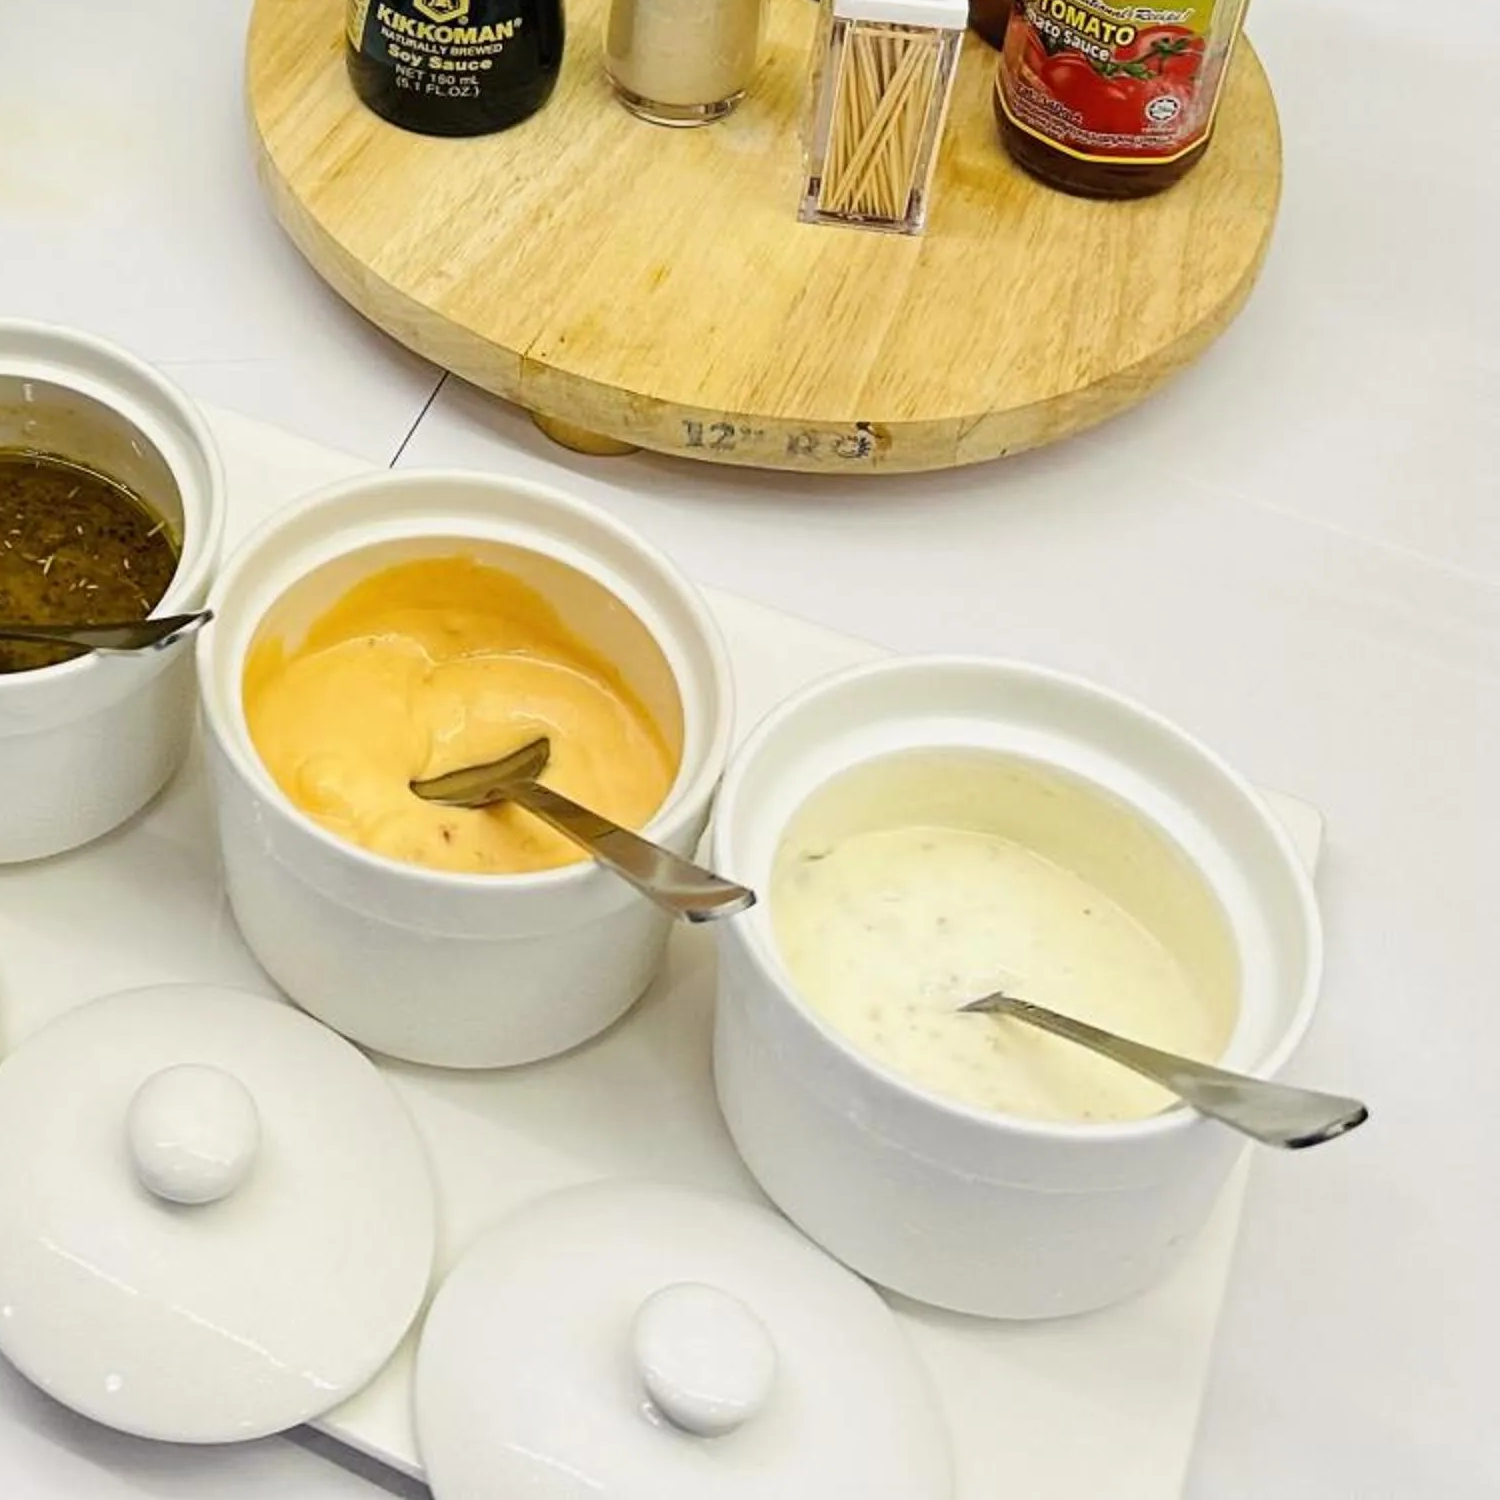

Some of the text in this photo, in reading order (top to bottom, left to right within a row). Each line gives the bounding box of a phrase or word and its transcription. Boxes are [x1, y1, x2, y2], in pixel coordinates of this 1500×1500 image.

[377, 3, 515, 45] KIKKOMAN
[381, 26, 504, 56] NATURALLY BREWED
[1063, 29, 1111, 62] Sauce
[388, 43, 494, 72] Soy Sauce
[395, 64, 426, 81] NET
